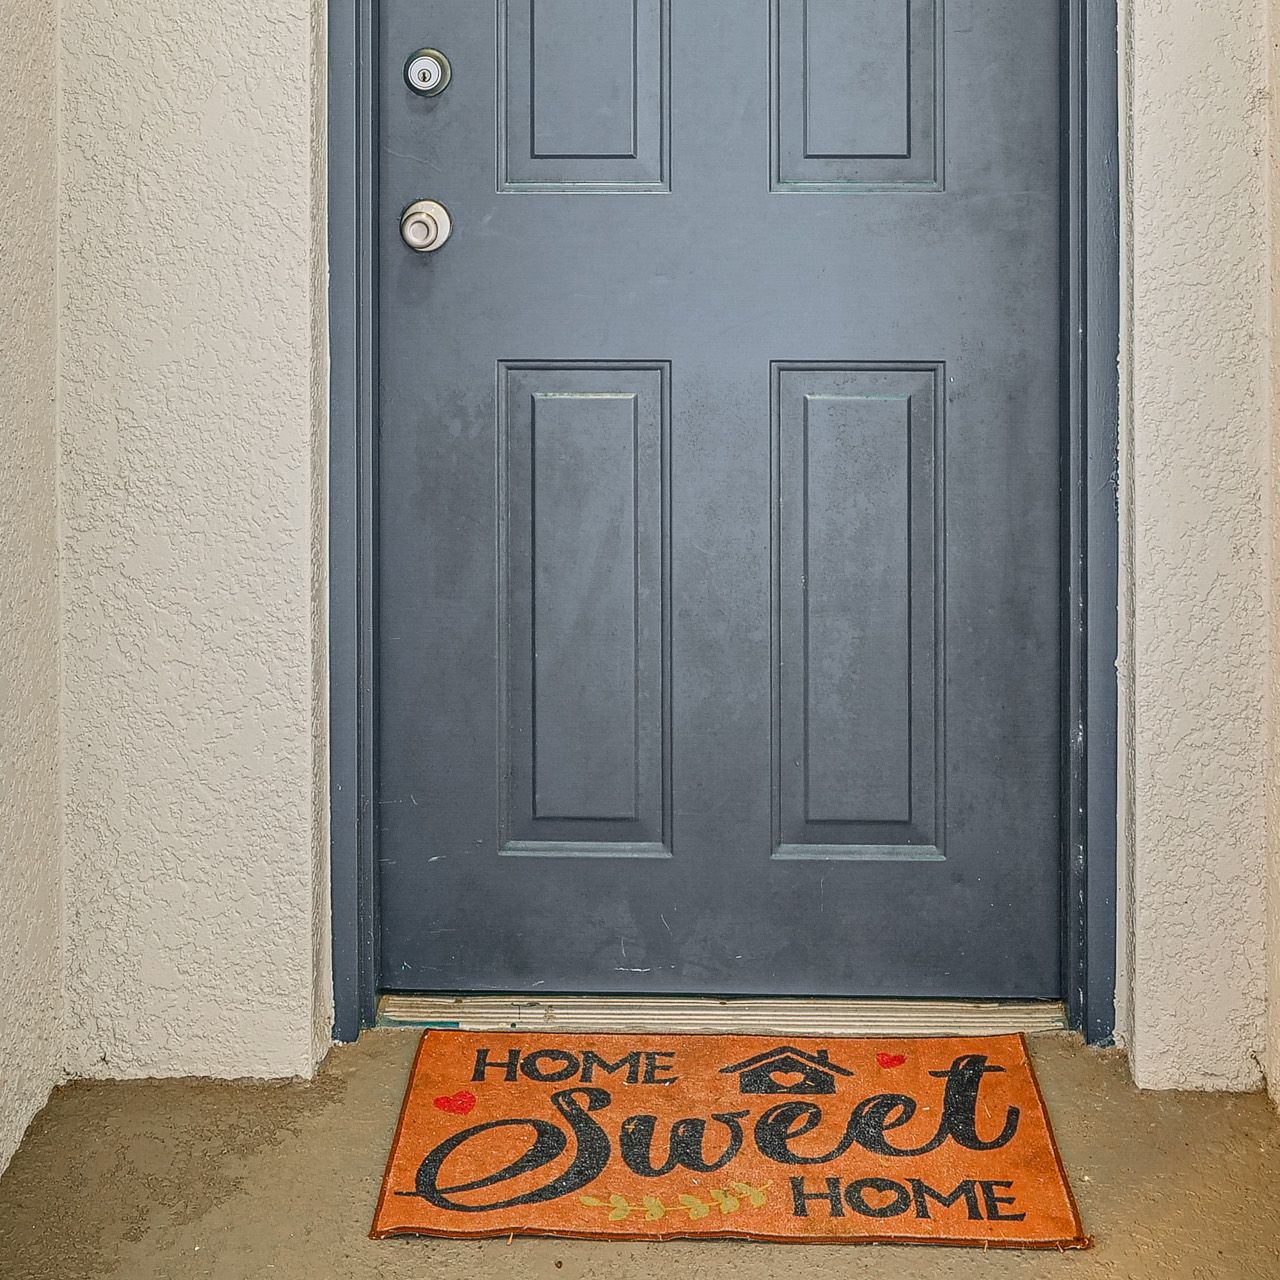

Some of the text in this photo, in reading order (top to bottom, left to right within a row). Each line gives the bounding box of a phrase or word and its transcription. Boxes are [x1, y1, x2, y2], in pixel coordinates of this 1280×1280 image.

[471, 1049, 679, 1084] HOME
[394, 1053, 1020, 1213] Sweet
[790, 1175, 1026, 1221] HOME
